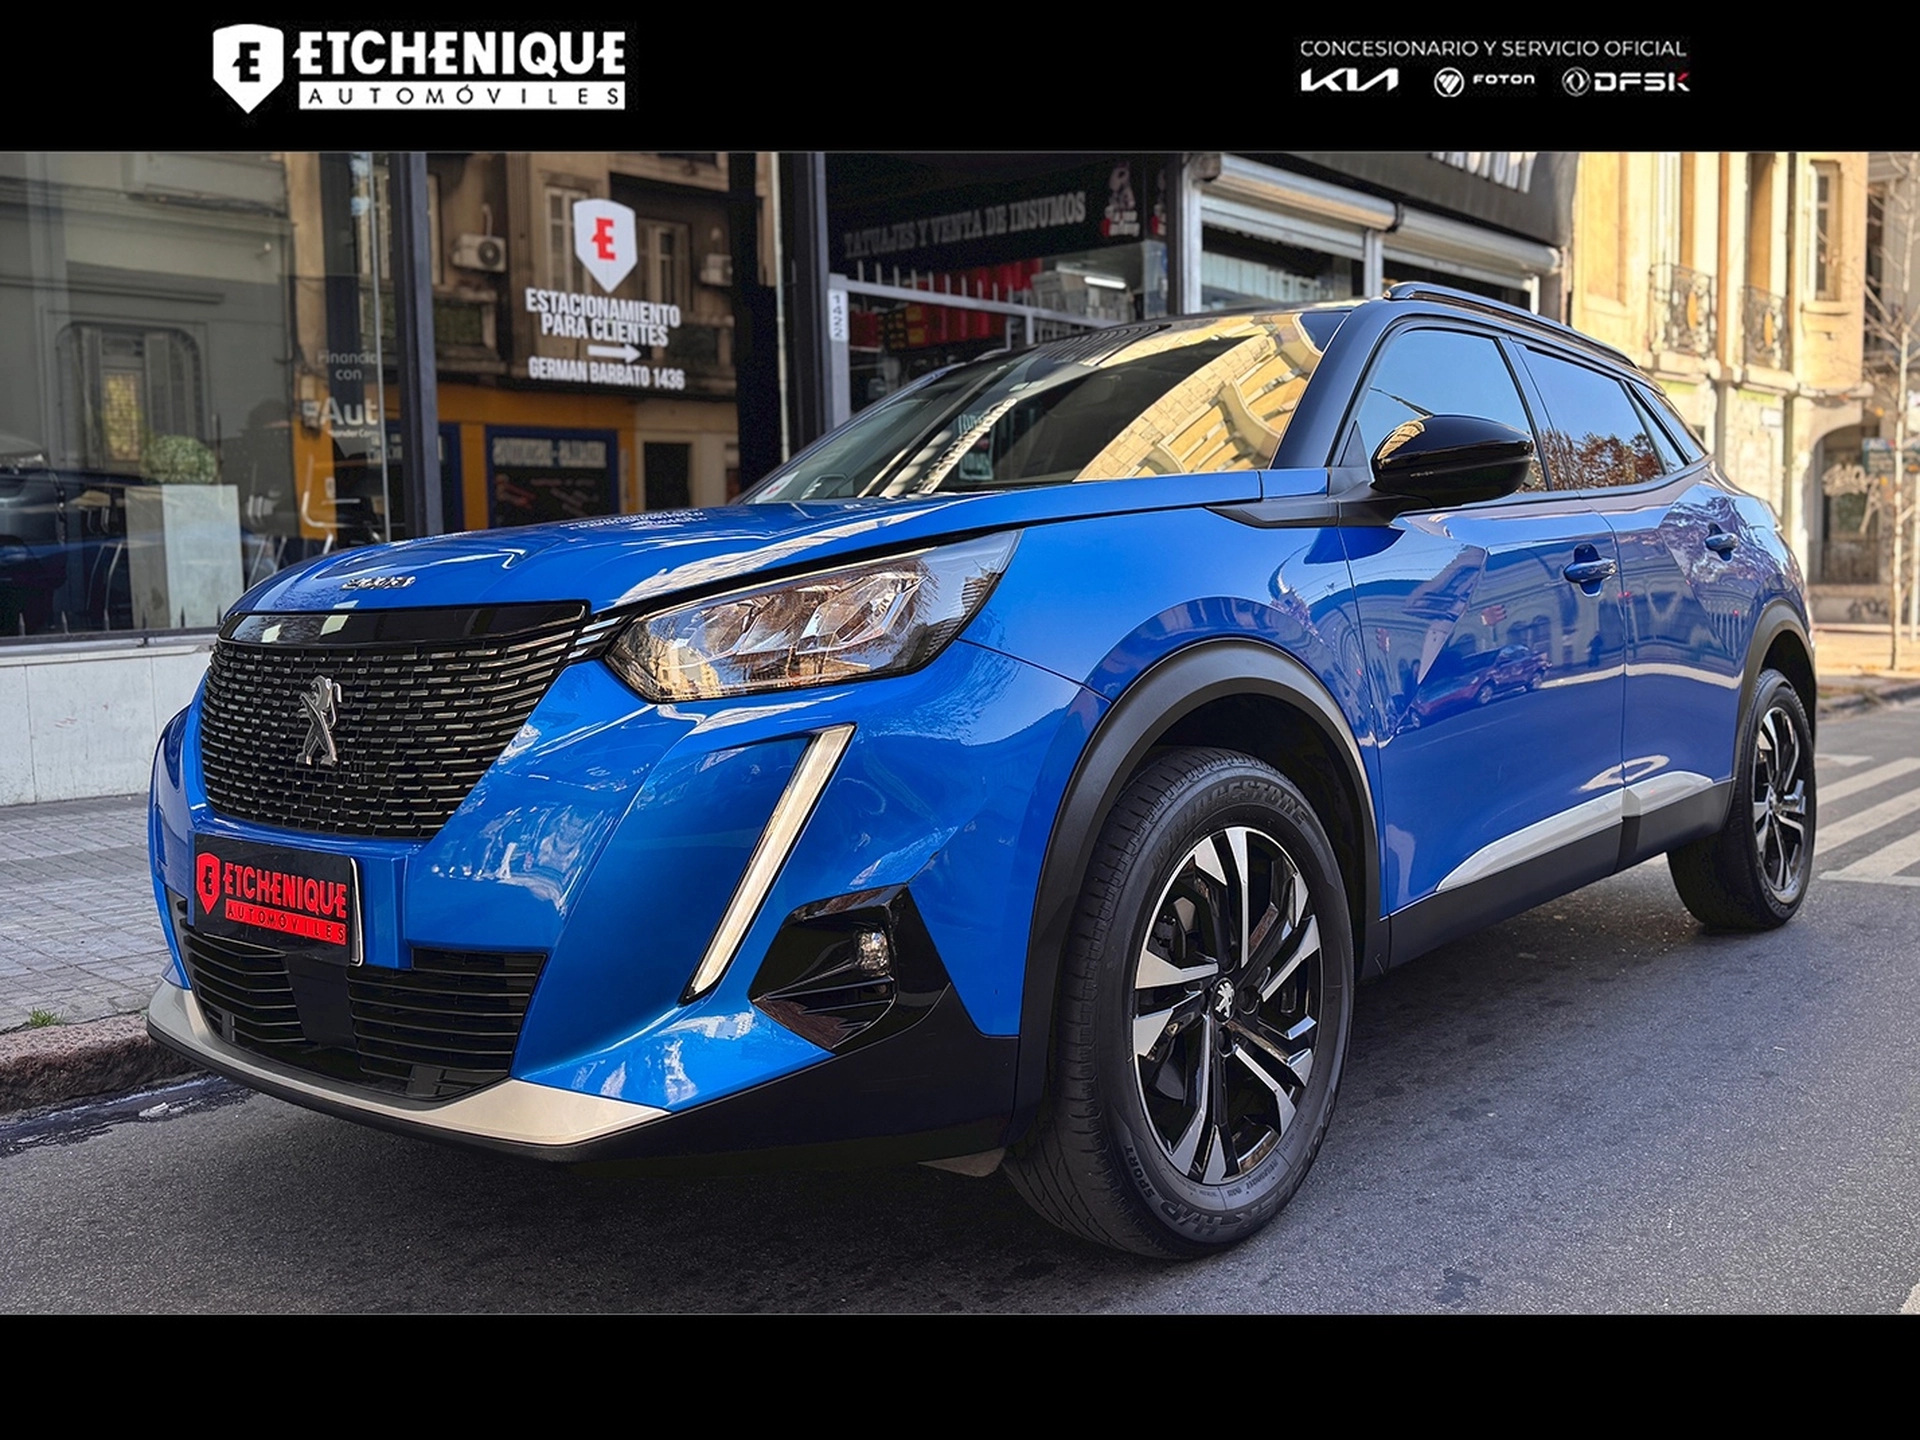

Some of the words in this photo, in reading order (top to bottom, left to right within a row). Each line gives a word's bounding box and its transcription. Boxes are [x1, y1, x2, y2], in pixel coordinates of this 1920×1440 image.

[844, 221, 917, 258] TATUAJES
[917, 218, 928, 247] Y
[930, 208, 984, 245] VENTA
[985, 204, 1008, 237] DE
[1009, 191, 1087, 233] INSUMOS
[525, 287, 681, 329] ESTACIONAMIENTO
[541, 313, 589, 340] PARA
[591, 318, 669, 348] CLIENTES
[335, 369, 362, 381] con
[528, 355, 588, 383] GERMAN
[590, 361, 651, 388] BARBATO
[223, 862, 347, 920] ETCHENIQUE
[227, 903, 345, 942] AUTOMÓVILES
[1123, 1144, 1155, 1198] SPORT
